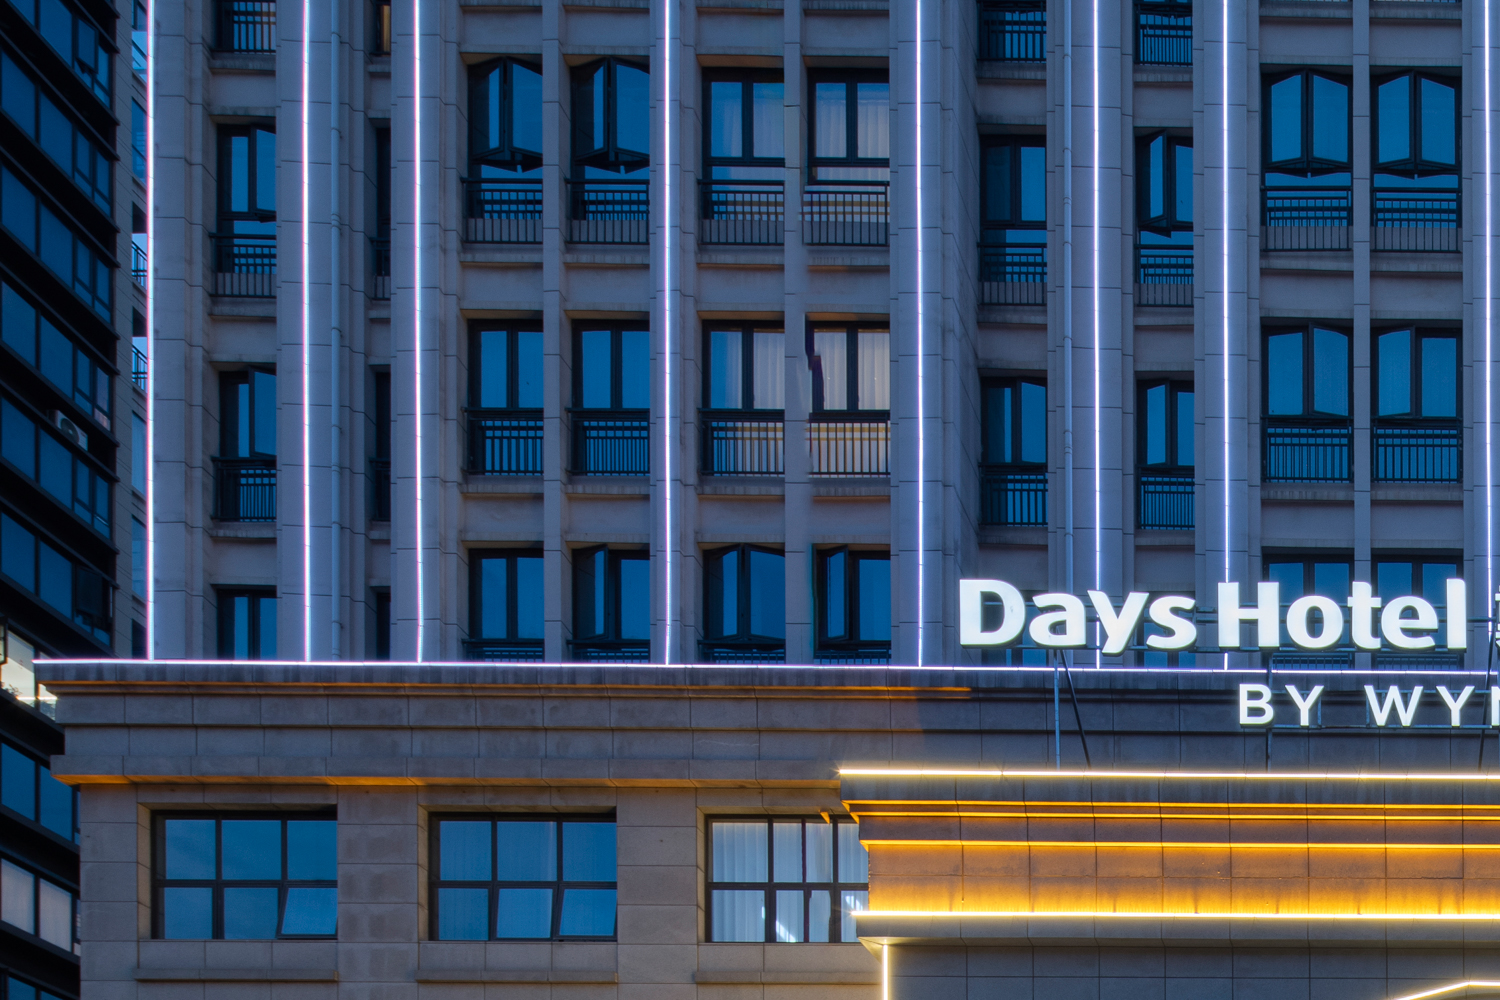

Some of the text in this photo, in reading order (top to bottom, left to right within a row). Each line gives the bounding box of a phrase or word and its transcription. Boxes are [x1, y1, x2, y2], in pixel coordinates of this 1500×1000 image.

[959, 579, 1467, 654] Days Hotel
[1239, 683, 1324, 726] BY
